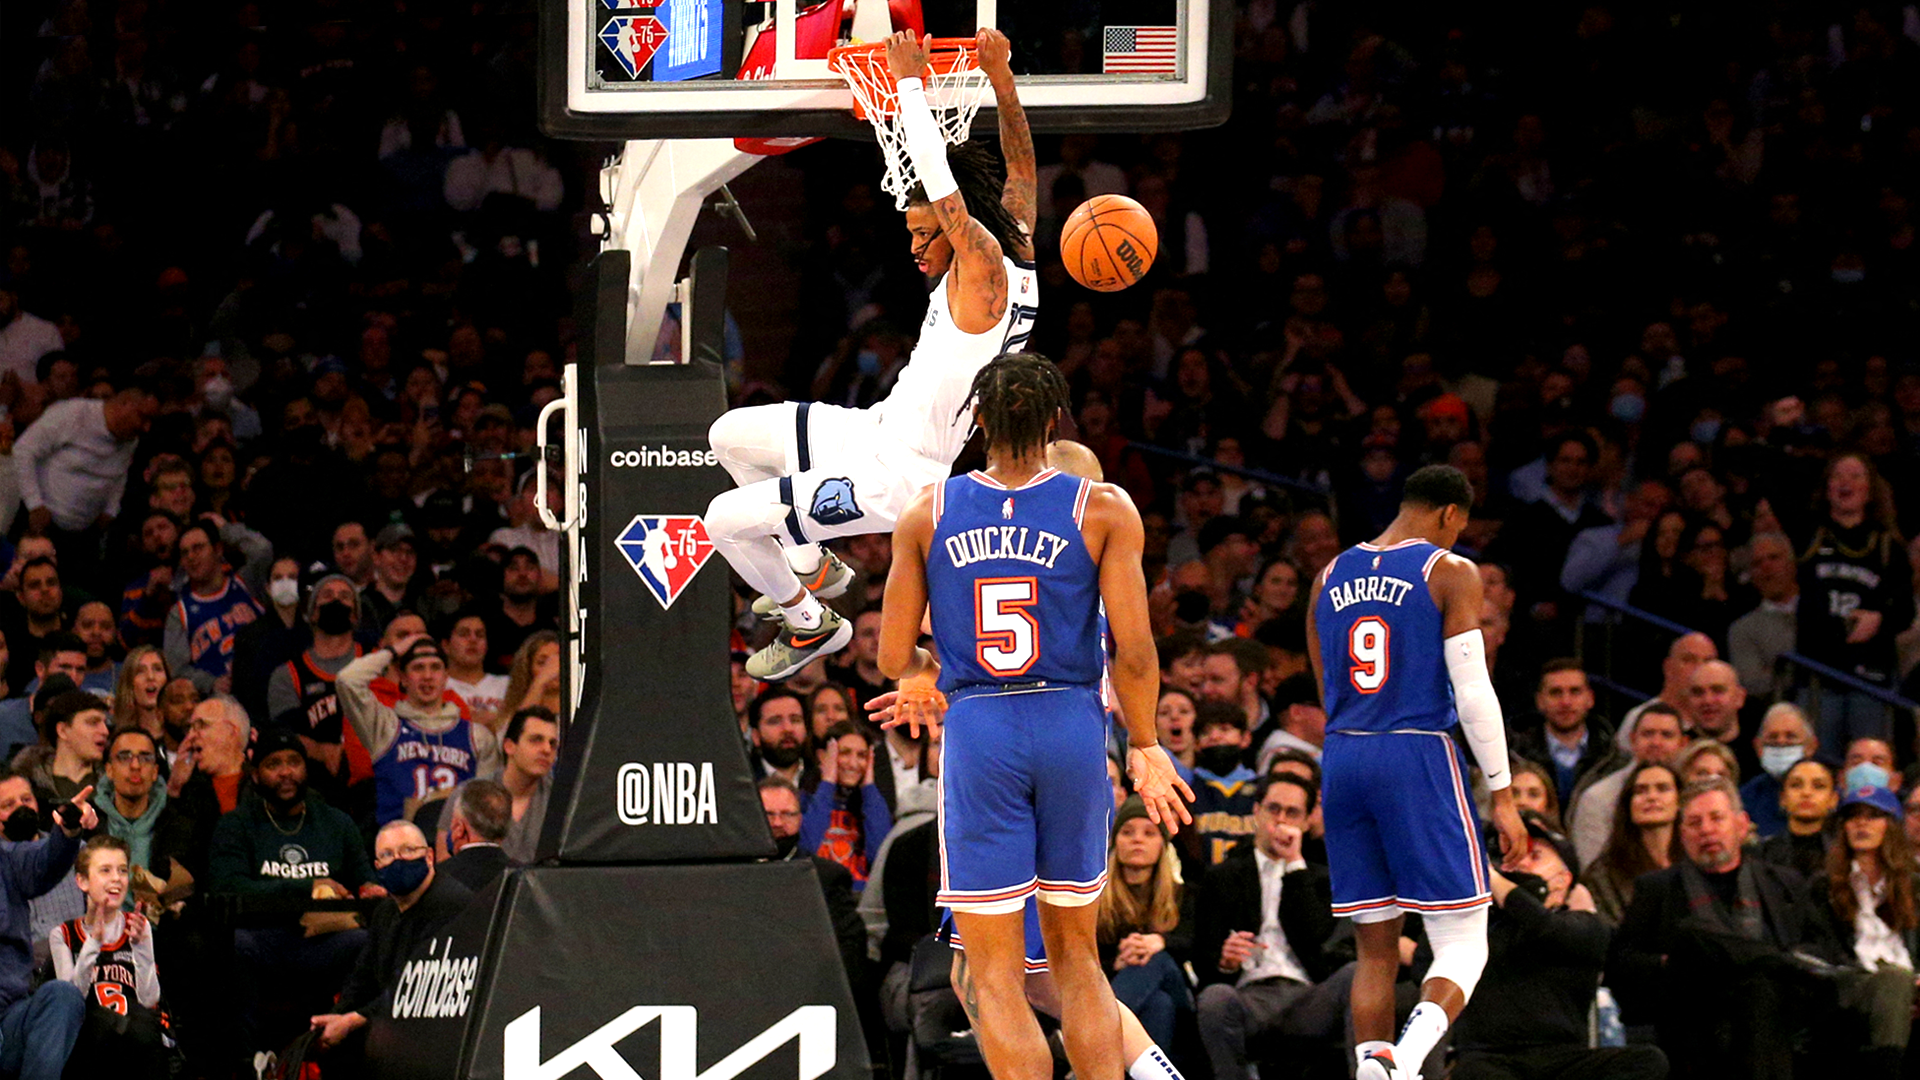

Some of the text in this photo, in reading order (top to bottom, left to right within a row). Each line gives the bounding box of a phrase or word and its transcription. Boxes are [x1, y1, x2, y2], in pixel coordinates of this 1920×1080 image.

[640, 25, 654, 44] 75
[610, 445, 719, 467] coinbase
[677, 529, 697, 556] 75
[945, 526, 1070, 569] QUICKLEY
[1328, 576, 1414, 612] BARRETT
[974, 576, 1041, 677] 5
[1348, 615, 1391, 694] 9
[307, 694, 337, 729] NEW
[396, 741, 471, 773] NEW YORK
[616, 762, 718, 826] @NBA
[260, 860, 330, 879] ARGESTES
[392, 936, 479, 1019] coinbase
[94, 981, 129, 1017] 5
